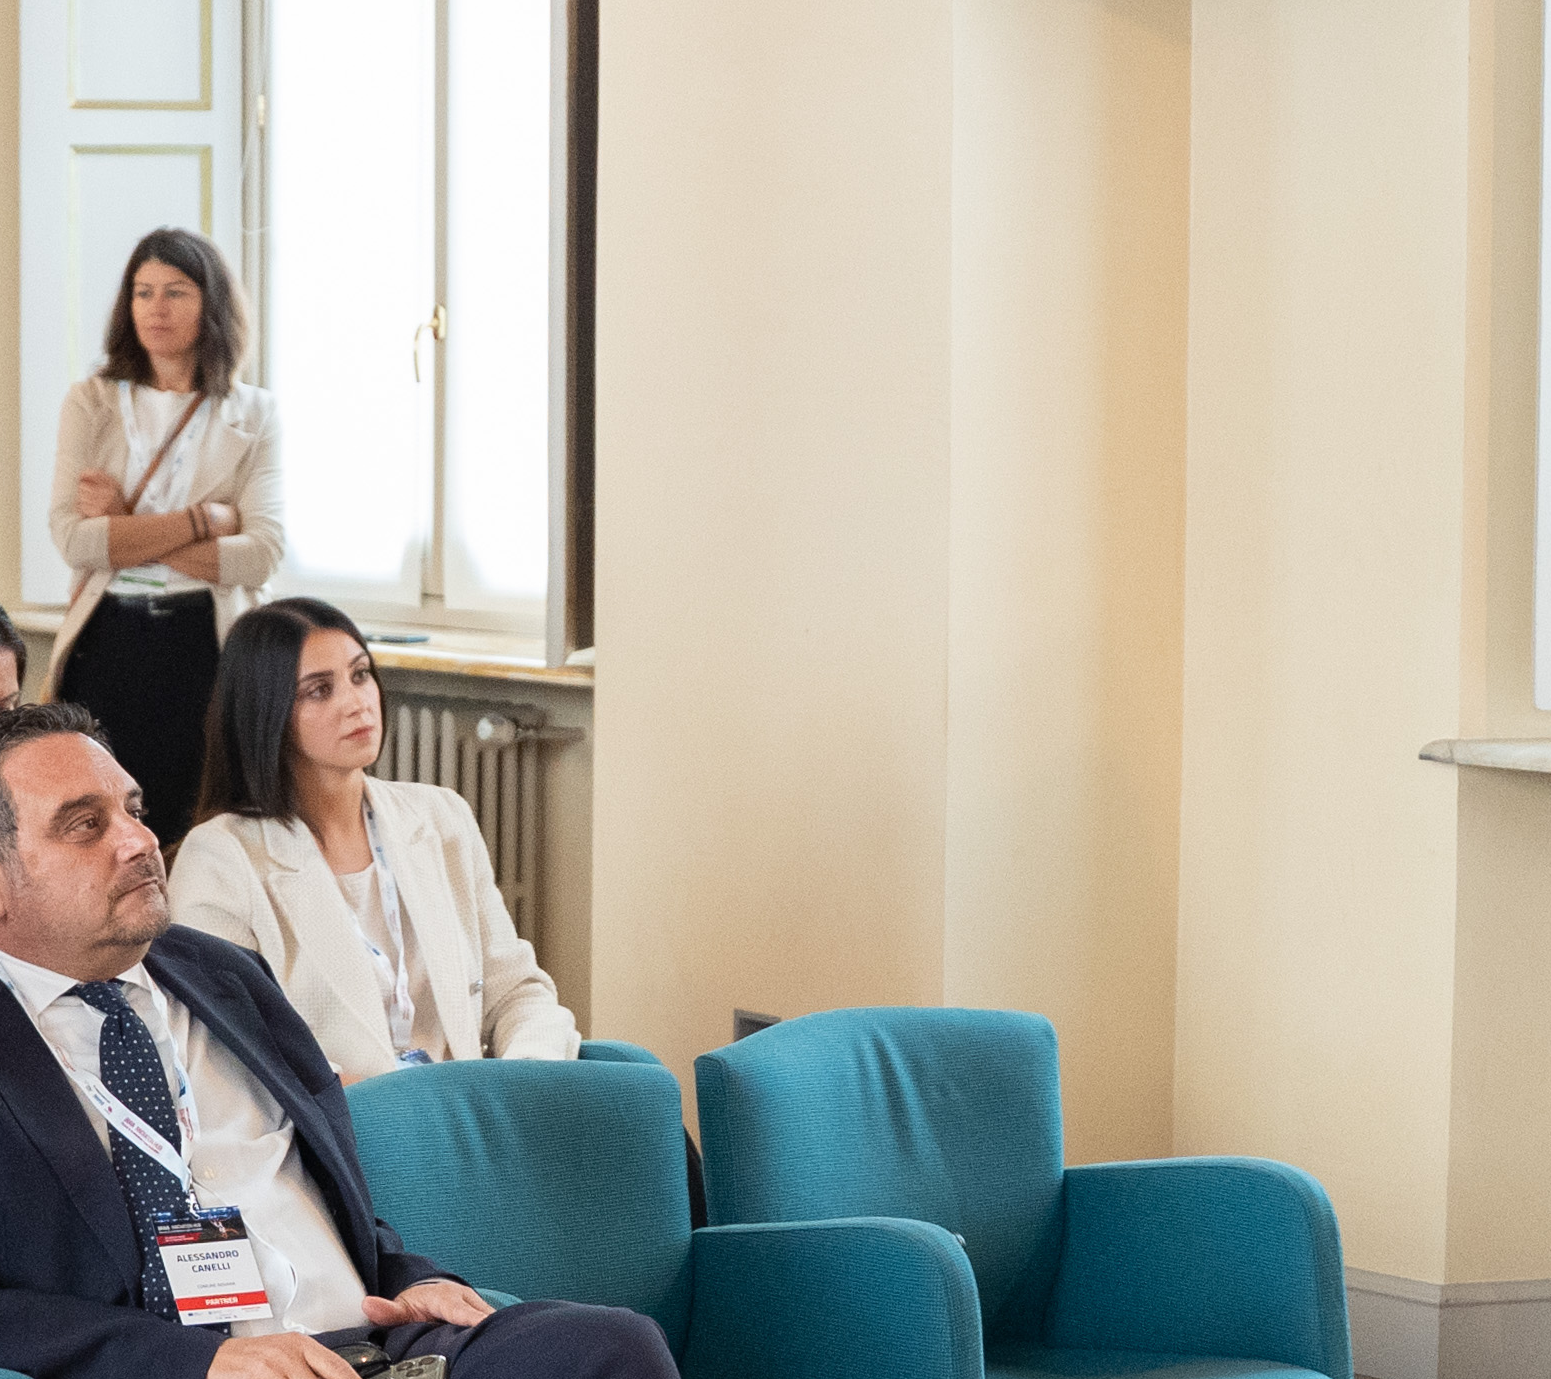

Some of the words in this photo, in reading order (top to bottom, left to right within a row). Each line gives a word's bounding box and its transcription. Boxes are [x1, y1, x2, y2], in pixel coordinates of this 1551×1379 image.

[176, 1249, 239, 1263] ALESSANDRO
[192, 1263, 231, 1273] CANELLI
[205, 1296, 239, 1306] PARTNER
